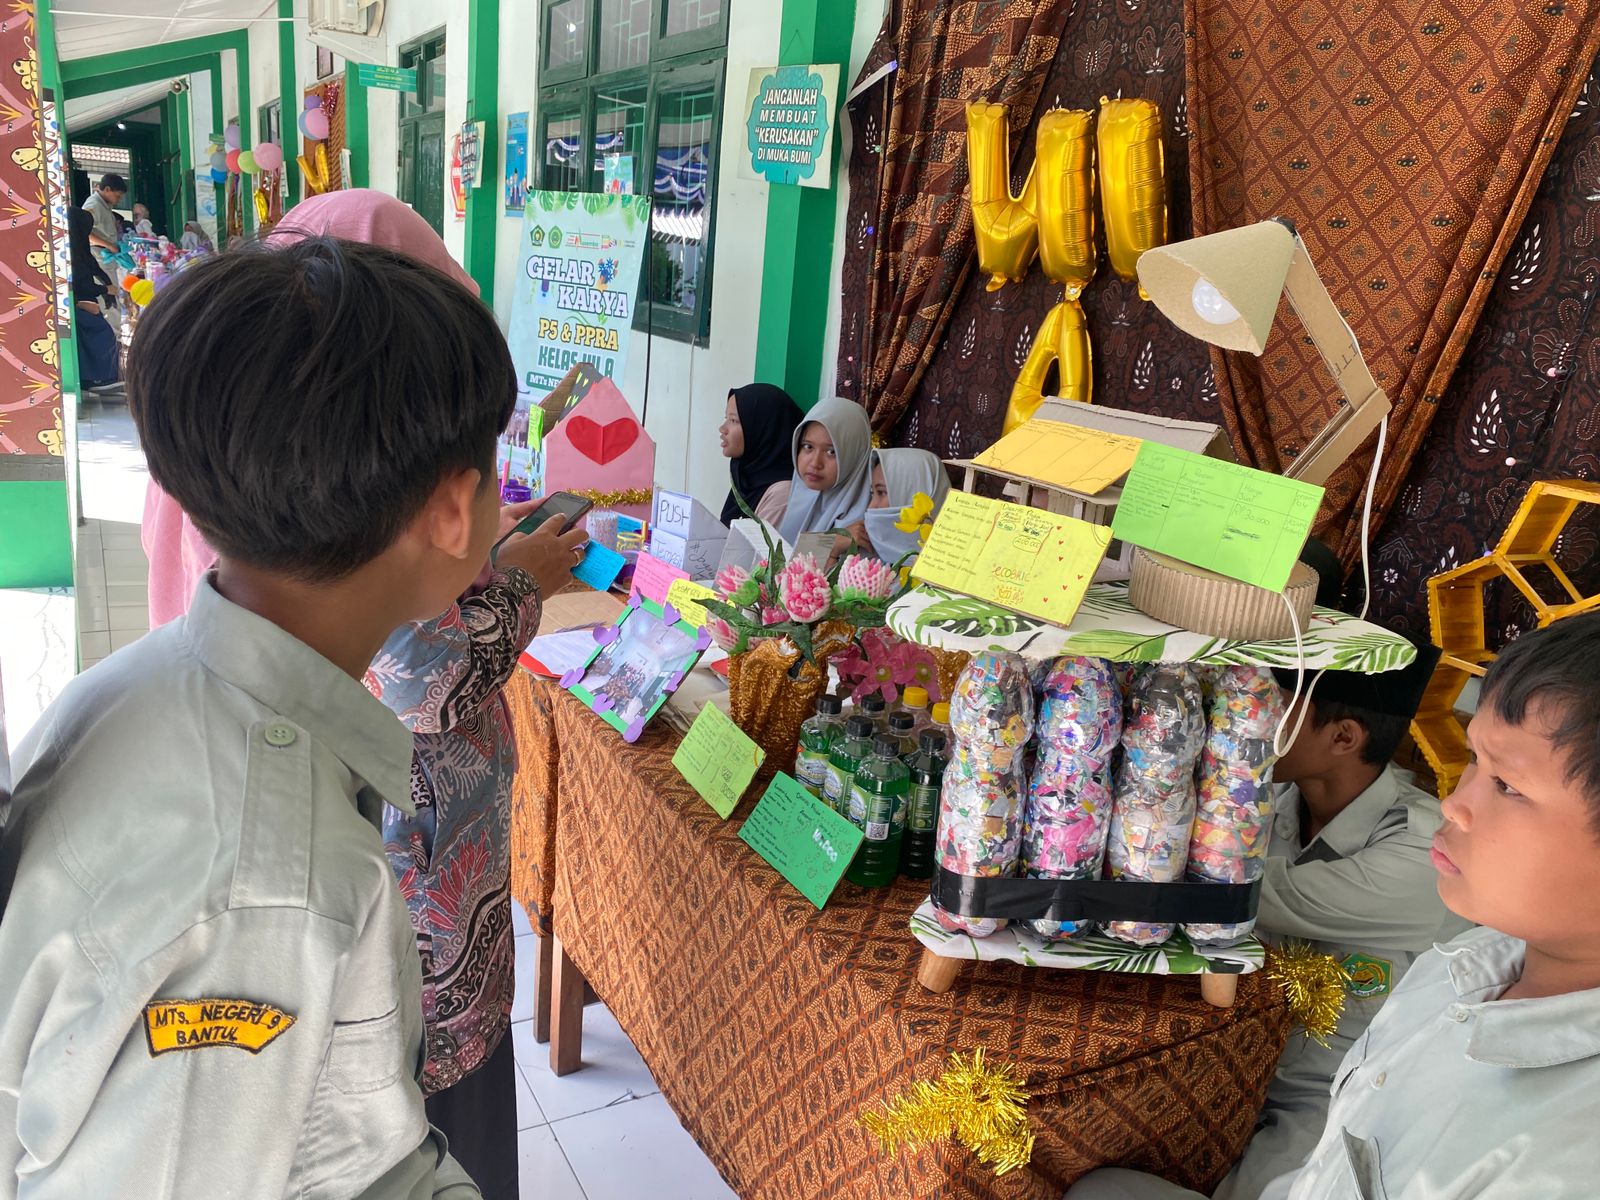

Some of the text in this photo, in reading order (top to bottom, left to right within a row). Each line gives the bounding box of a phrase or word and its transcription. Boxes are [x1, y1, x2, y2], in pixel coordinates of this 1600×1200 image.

[763, 88, 818, 106] JANGANLAH
[760, 109, 817, 124] MEMBUAT
[757, 147, 812, 165] DI MUKA BUMI
[526, 255, 595, 287] GELAR
[557, 285, 629, 318] KARYA
[537, 318, 620, 352] P5 & PPRA
[537, 345, 579, 371] KELAS
[200, 1004, 266, 1025] NEGERI
[267, 1014, 281, 1030] 9
[176, 1026, 239, 1045] BANTUL
